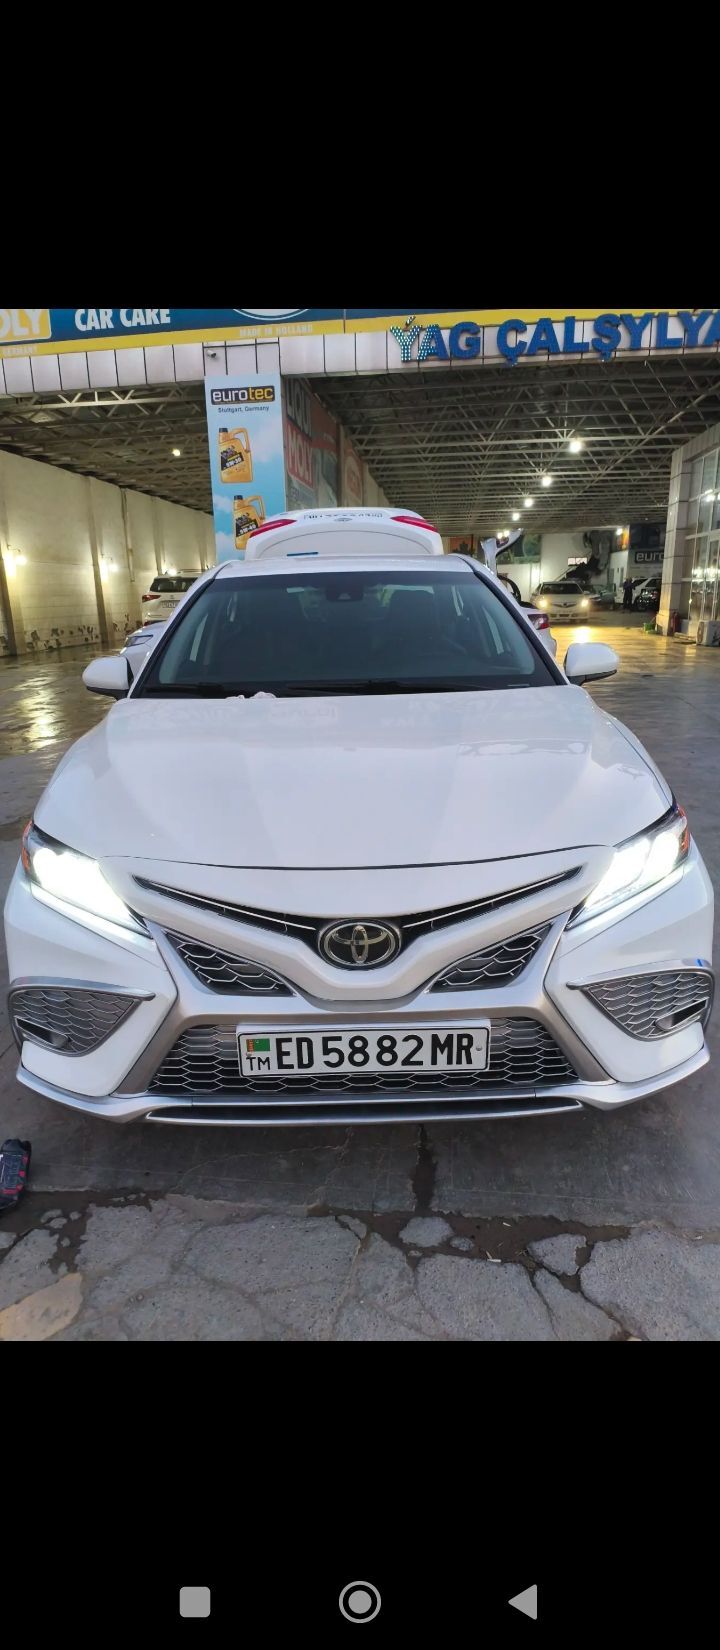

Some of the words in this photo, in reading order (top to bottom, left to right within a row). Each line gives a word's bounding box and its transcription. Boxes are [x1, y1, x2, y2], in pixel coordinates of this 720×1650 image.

[75, 309, 114, 331] CAR
[212, 387, 274, 402] eurotec
[246, 1056, 271, 1071] TM
